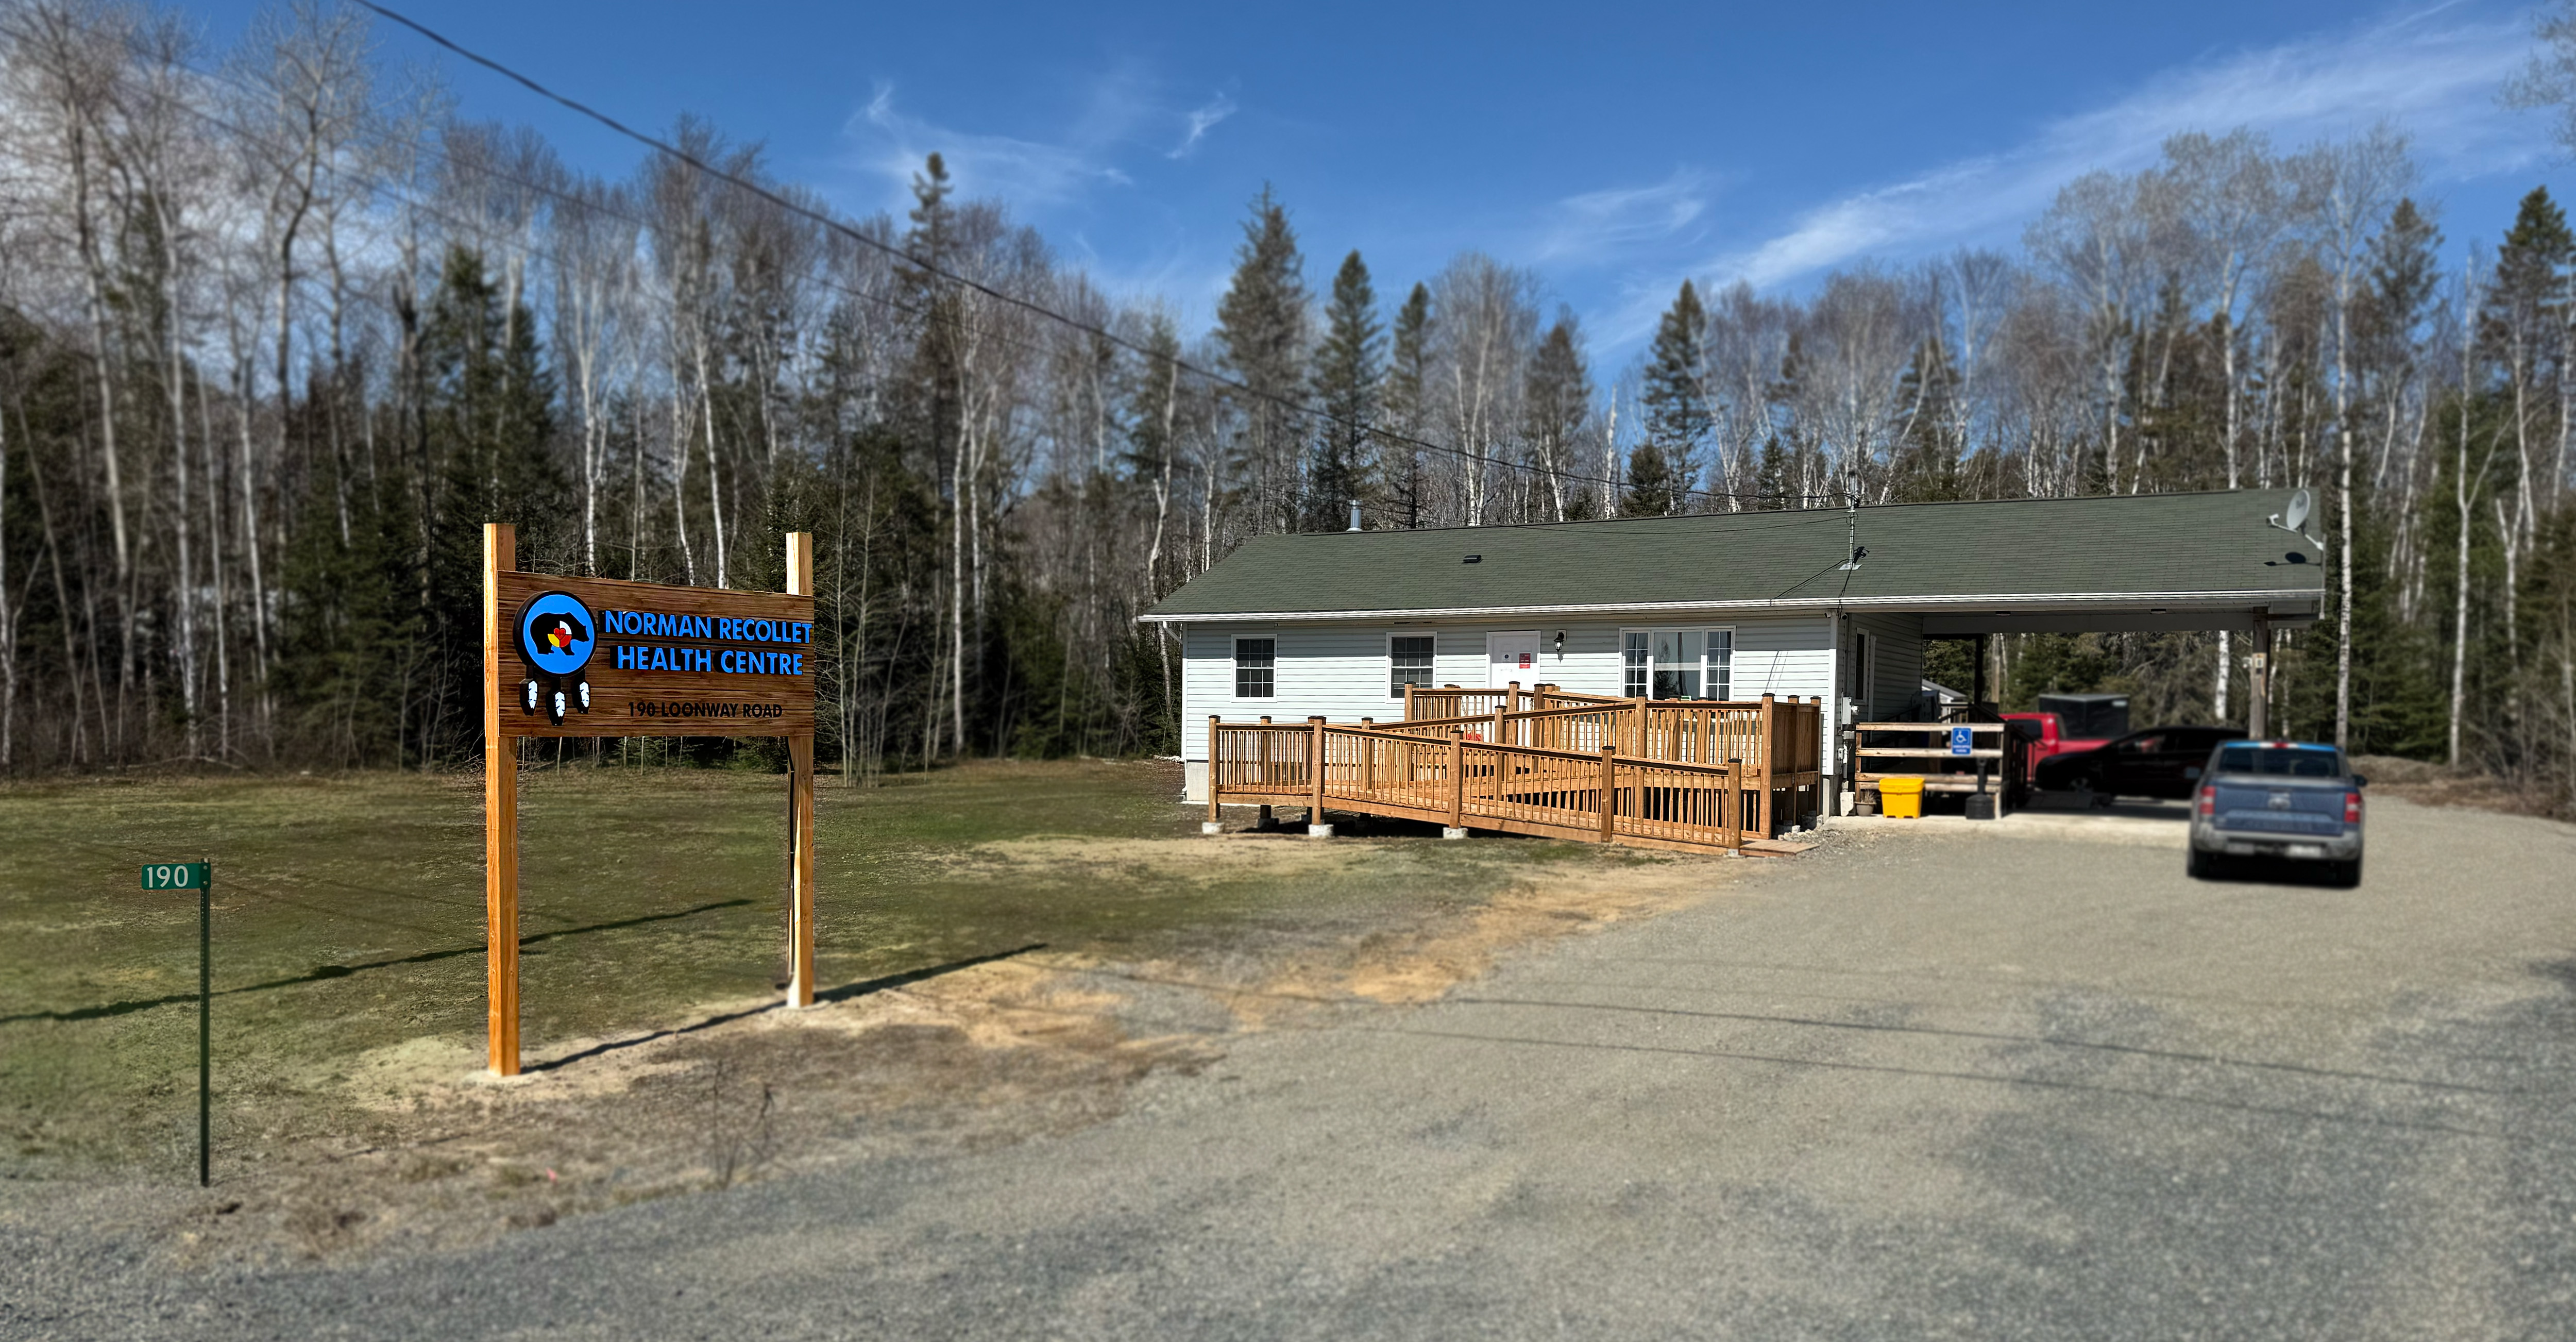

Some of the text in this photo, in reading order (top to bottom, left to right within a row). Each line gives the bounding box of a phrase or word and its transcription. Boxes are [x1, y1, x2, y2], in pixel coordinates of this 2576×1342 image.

[605, 610, 813, 644] NORMAN RECOLLET
[618, 645, 803, 676] HEALTH CENTRE
[628, 701, 783, 718] 190 LOONWAY ROAD
[147, 865, 189, 888] 190
